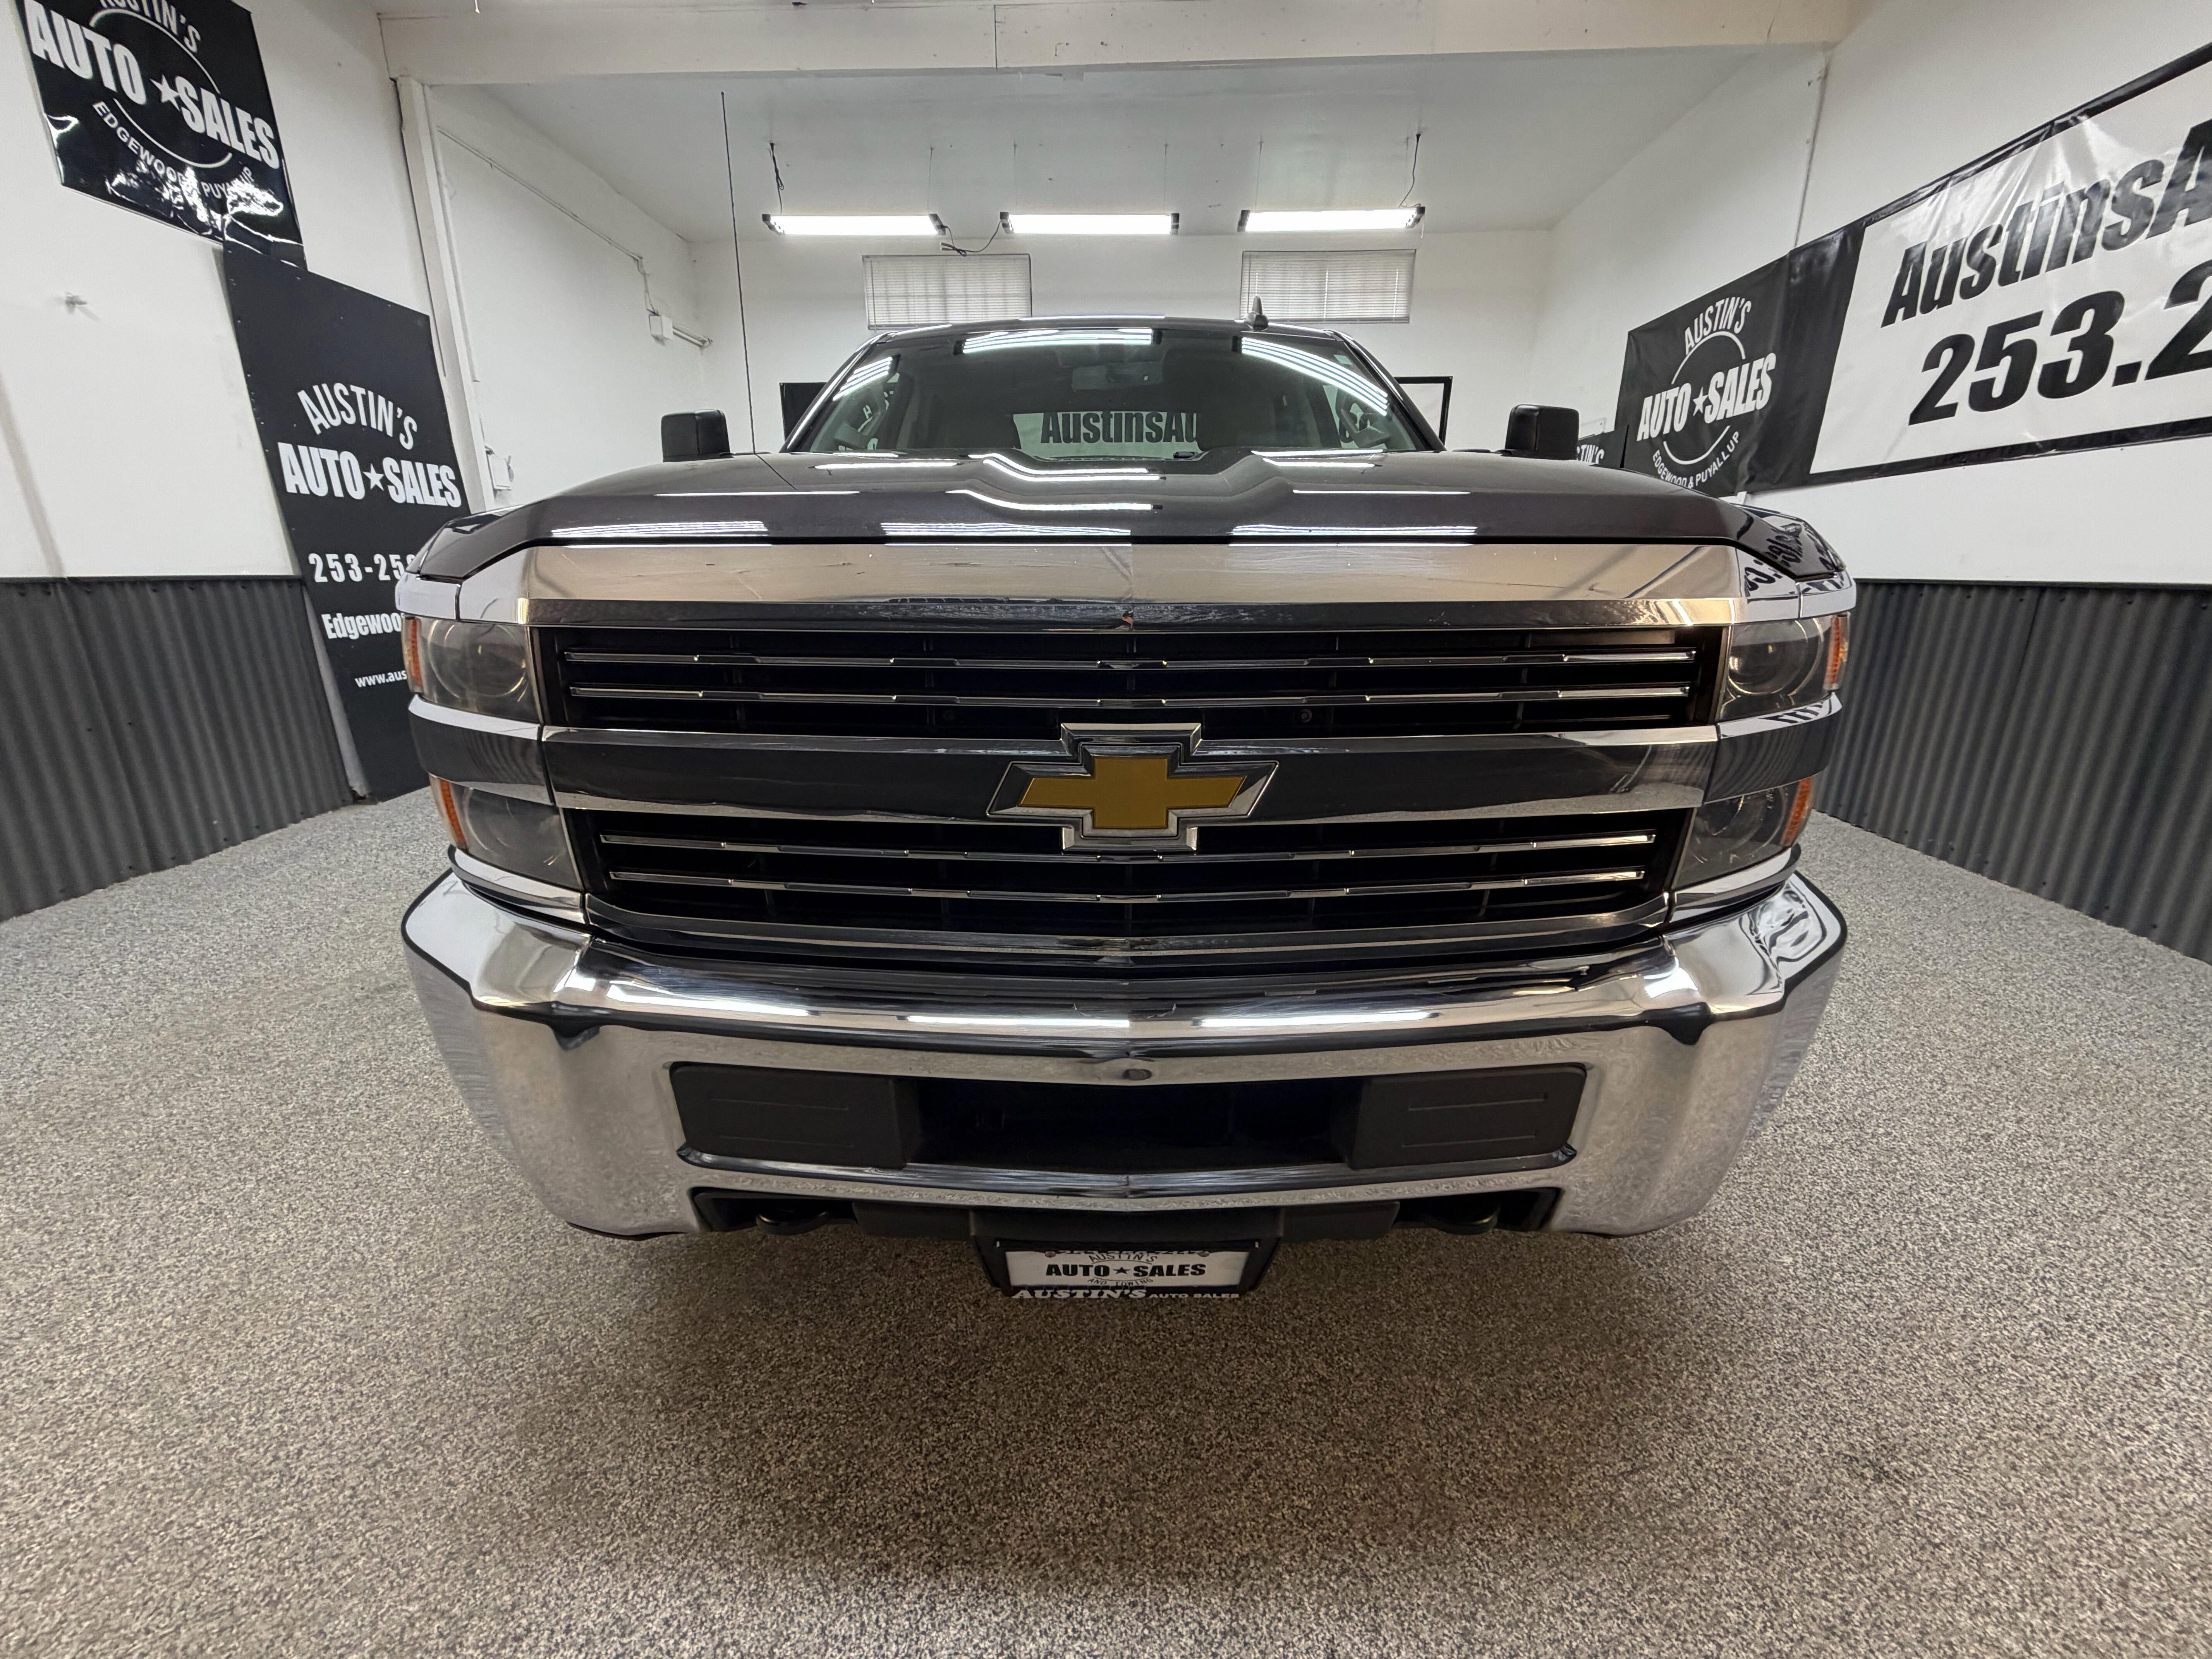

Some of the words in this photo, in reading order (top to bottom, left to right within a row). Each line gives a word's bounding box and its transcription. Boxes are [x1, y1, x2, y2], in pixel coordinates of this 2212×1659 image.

[24, 0, 146, 105] AUTO
[174, 76, 280, 169] SALES
[1685, 296, 1751, 354] AUSTIN'S
[1908, 259, 2212, 426] 253.2
[297, 383, 417, 450] AUSTIN'S
[1636, 383, 1692, 441] AUTO
[1704, 353, 1776, 424] SALES
[277, 442, 365, 500] AUTO
[382, 457, 462, 507] SALES
[1696, 431, 1739, 486] PUYALLUP
[1012, 1289, 1147, 1298] AUSTIN'S
[1046, 1264, 1110, 1277] AUTO
[1133, 1264, 1206, 1277] SALES
